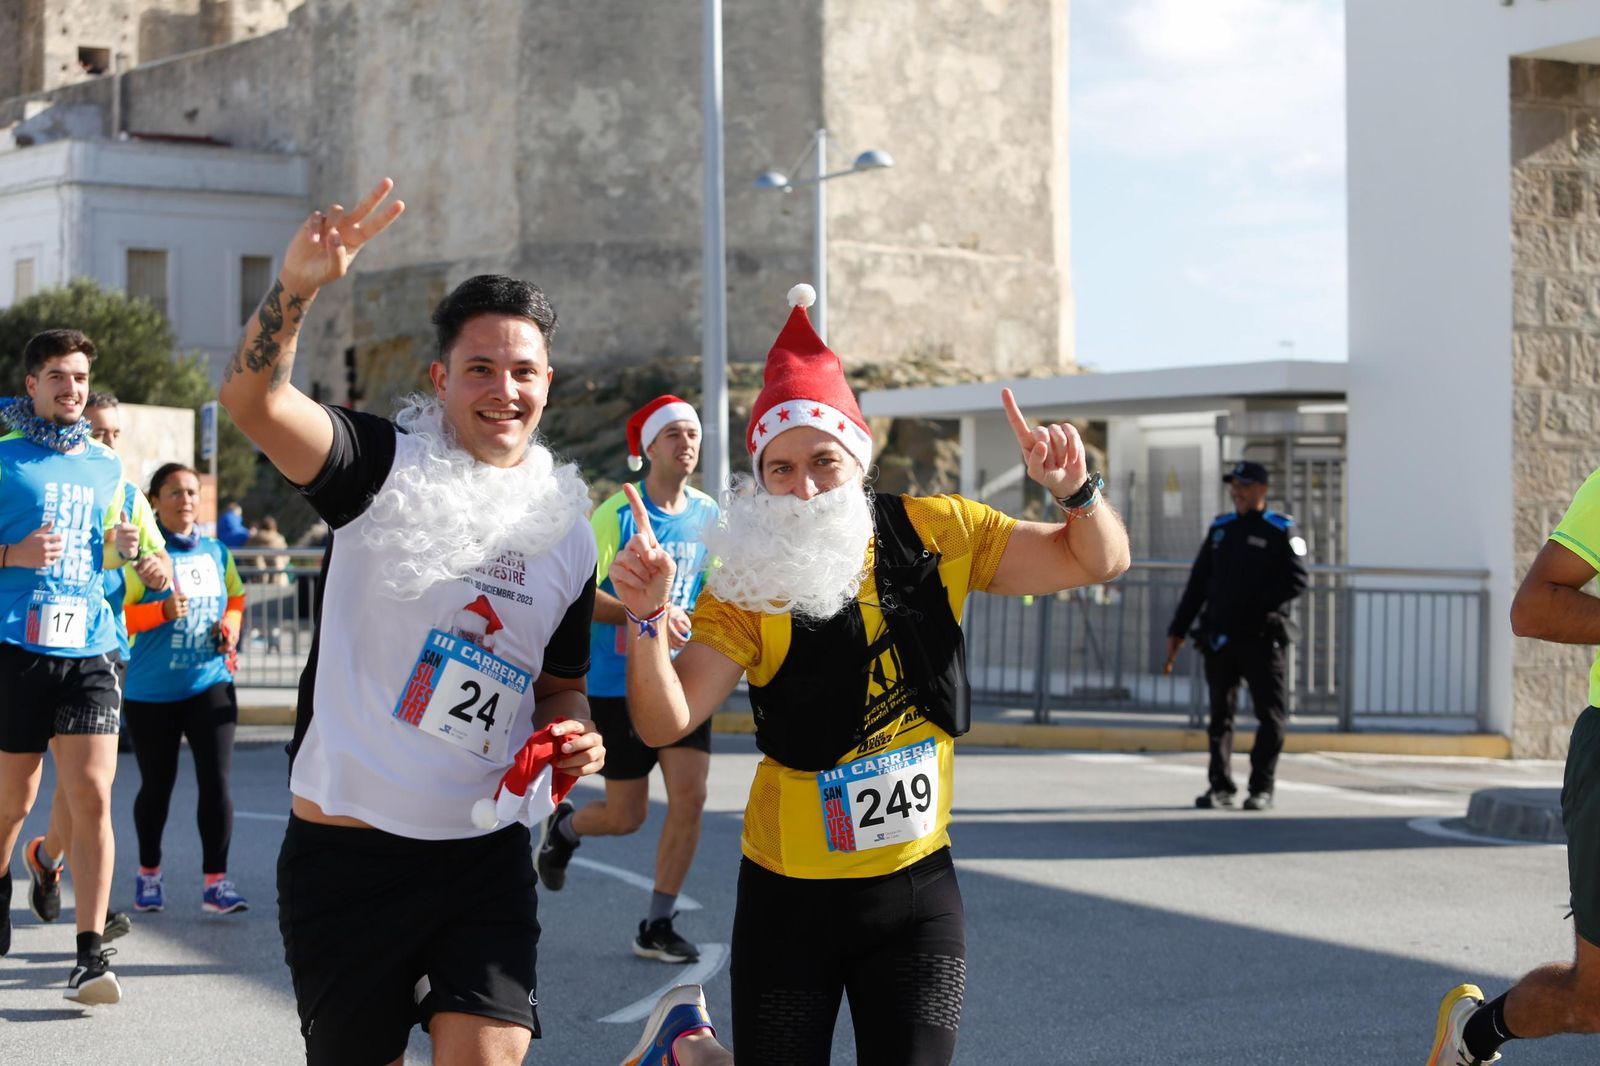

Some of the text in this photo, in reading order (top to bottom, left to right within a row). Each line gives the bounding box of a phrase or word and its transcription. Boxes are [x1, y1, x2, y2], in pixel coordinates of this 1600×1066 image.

[61, 483, 94, 505] SAN
[57, 501, 93, 530] SIL
[191, 569, 201, 586] 9
[482, 583, 516, 601] DICIEMBRE
[516, 593, 533, 606] 2023
[53, 612, 74, 633] 17
[420, 649, 443, 669] SAN
[433, 634, 456, 651] III
[461, 645, 526, 687] CARRERA
[413, 662, 435, 687] SIL
[478, 664, 503, 682] TARIFA
[404, 679, 433, 707] VES
[397, 699, 427, 728] TRE
[449, 680, 500, 731] 24
[868, 735, 893, 752] 2022
[824, 742, 932, 782] III CARRERA
[876, 760, 910, 776] TARIFA
[823, 785, 842, 802] SAN
[856, 774, 931, 828] 249
[825, 799, 846, 819] SIL
[827, 816, 854, 836] VES
[830, 831, 856, 851] TRE
